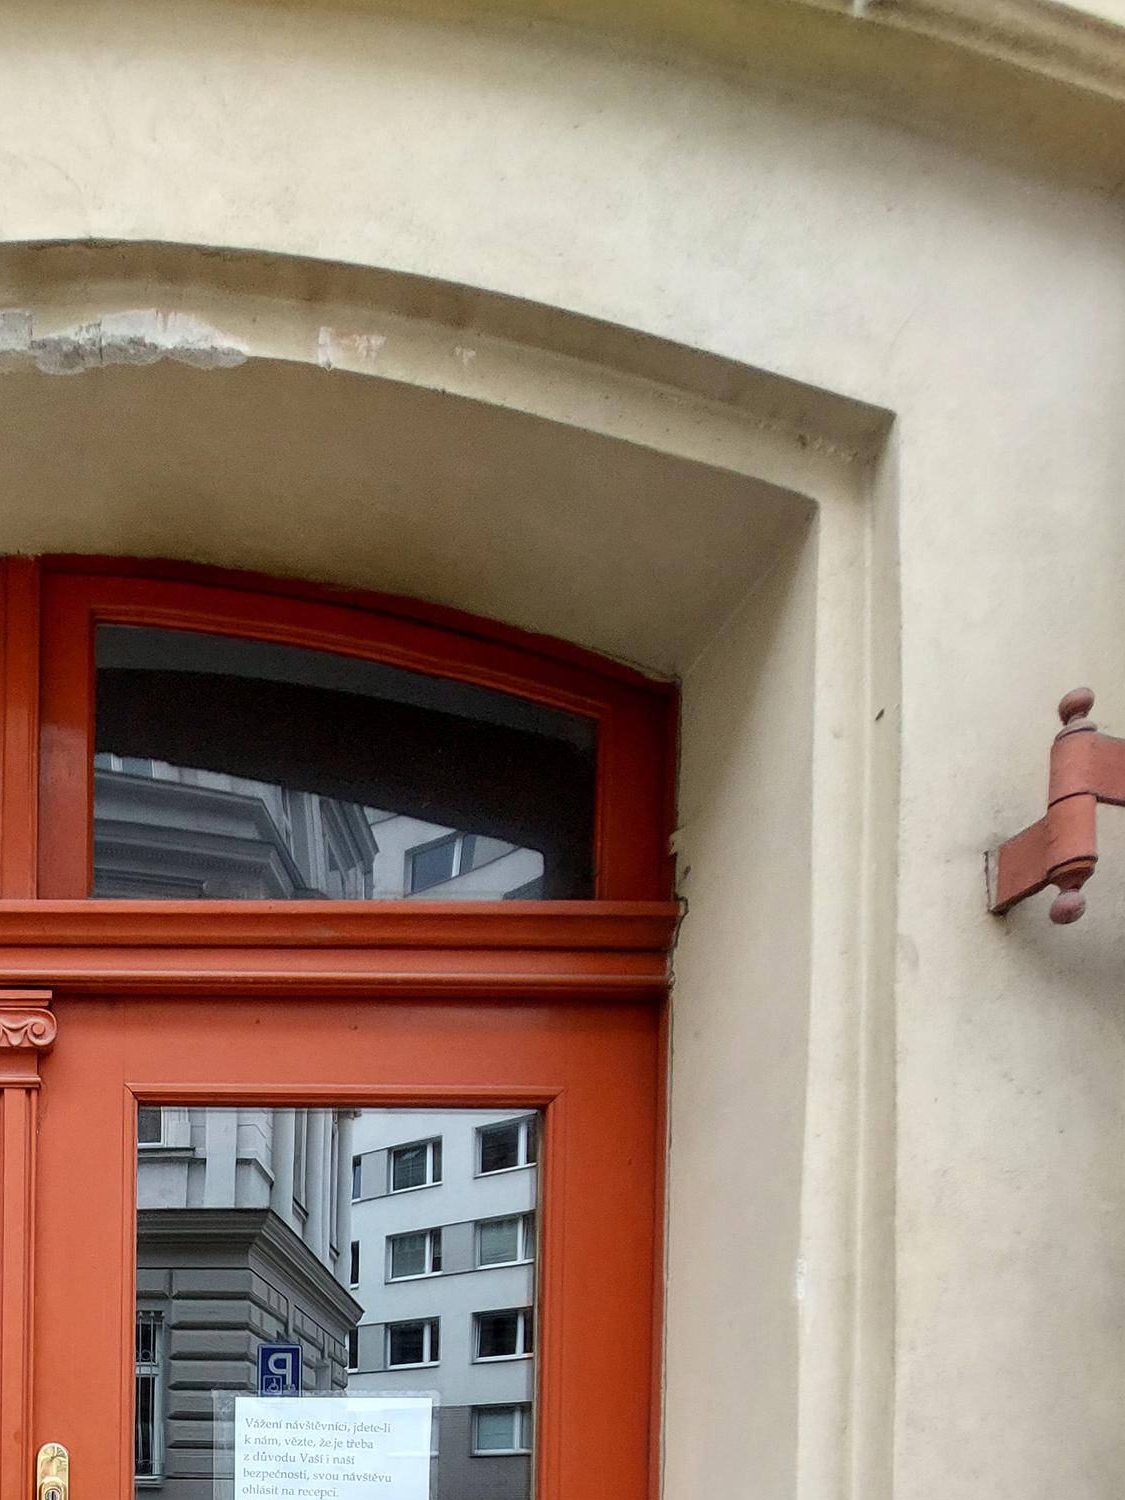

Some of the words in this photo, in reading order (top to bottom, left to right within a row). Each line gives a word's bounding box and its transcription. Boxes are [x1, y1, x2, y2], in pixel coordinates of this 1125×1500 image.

[245, 1417, 282, 1430] Vážení
[285, 1419, 351, 1433] návštěvníci,
[353, 1421, 391, 1434] jdete-li
[244, 1434, 252, 1444] k
[254, 1435, 281, 1447] nám,
[284, 1437, 316, 1448] vězte,
[319, 1437, 332, 1447] že
[333, 1439, 343, 1449] je
[346, 1438, 374, 1449] třeba
[243, 1453, 251, 1461] z
[253, 1451, 296, 1463] důvodu
[300, 1452, 323, 1464] Vaší
[332, 1454, 355, 1465] naší
[243, 1468, 310, 1481] bezpečnosti,
[313, 1472, 339, 1481] svou
[342, 1471, 392, 1483] návštěvu
[242, 1484, 279, 1496] ohlásit
[281, 1487, 295, 1496] na
[297, 1487, 339, 1499] recepci.
